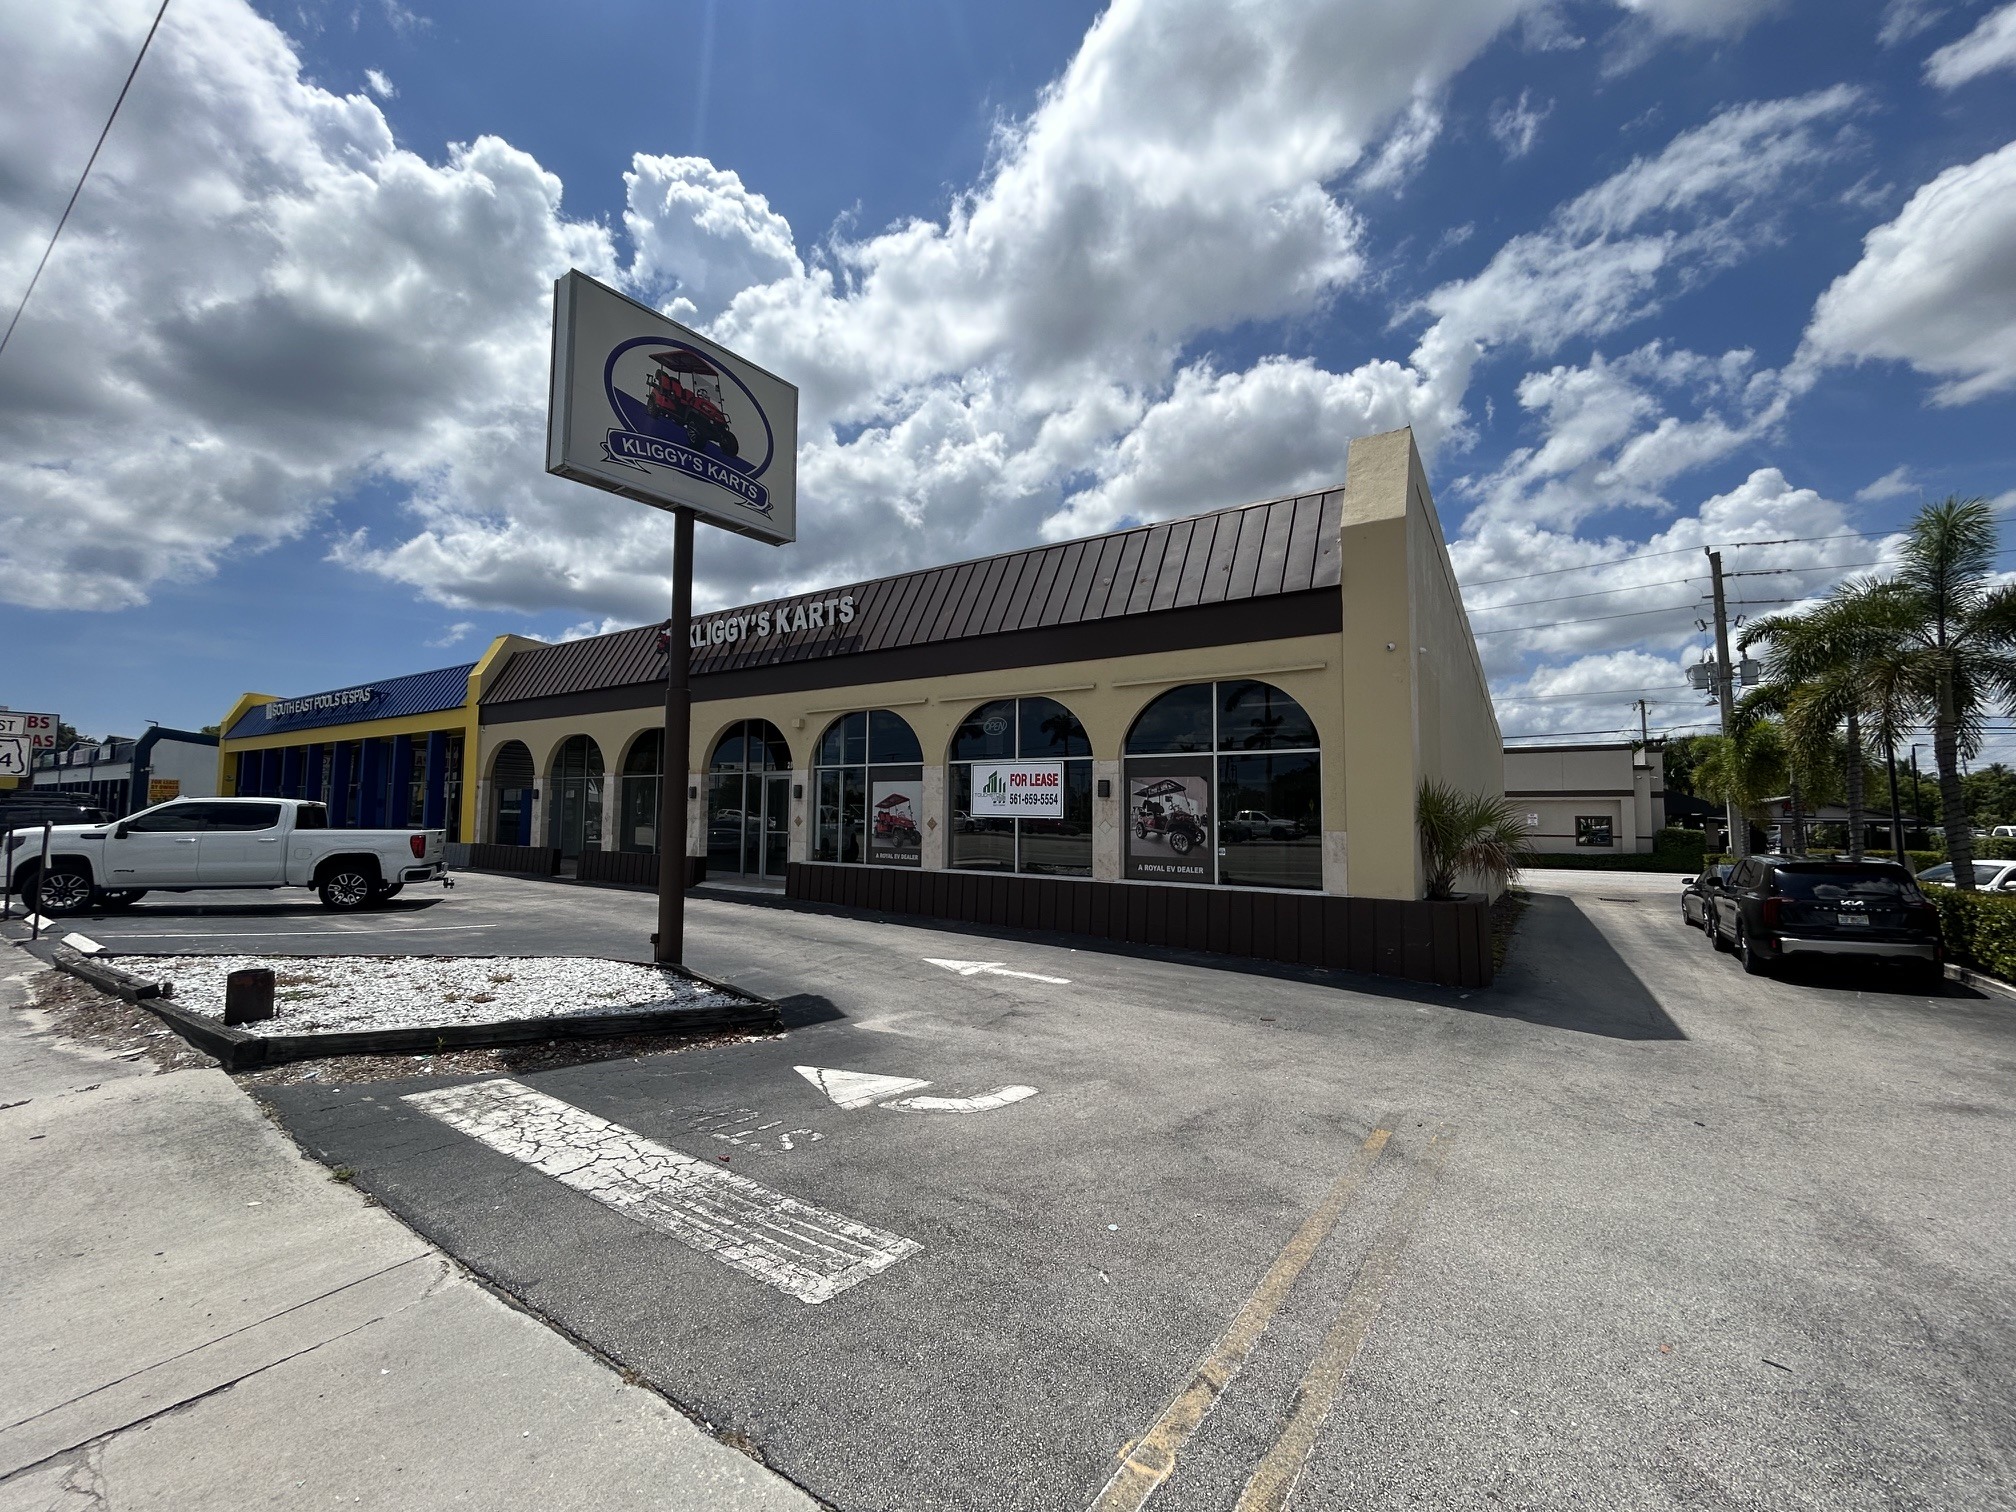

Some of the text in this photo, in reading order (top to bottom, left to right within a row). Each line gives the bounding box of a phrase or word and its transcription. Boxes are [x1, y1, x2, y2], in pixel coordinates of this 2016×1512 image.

[622, 437, 758, 499] KLIGGY'S KARTS
[776, 595, 855, 635] KARTS
[272, 687, 372, 717] SOUTH EAST POOLS & SPAS
[984, 721, 1005, 731] OPEN
[25, 734, 55, 748] AS
[1009, 773, 1059, 787] FOR LEASE
[1009, 793, 1059, 806] 561-659-5554
[1144, 864, 1165, 872] ROYAL
[1166, 865, 1176, 873] EV
[1176, 866, 1204, 874] DEALER
